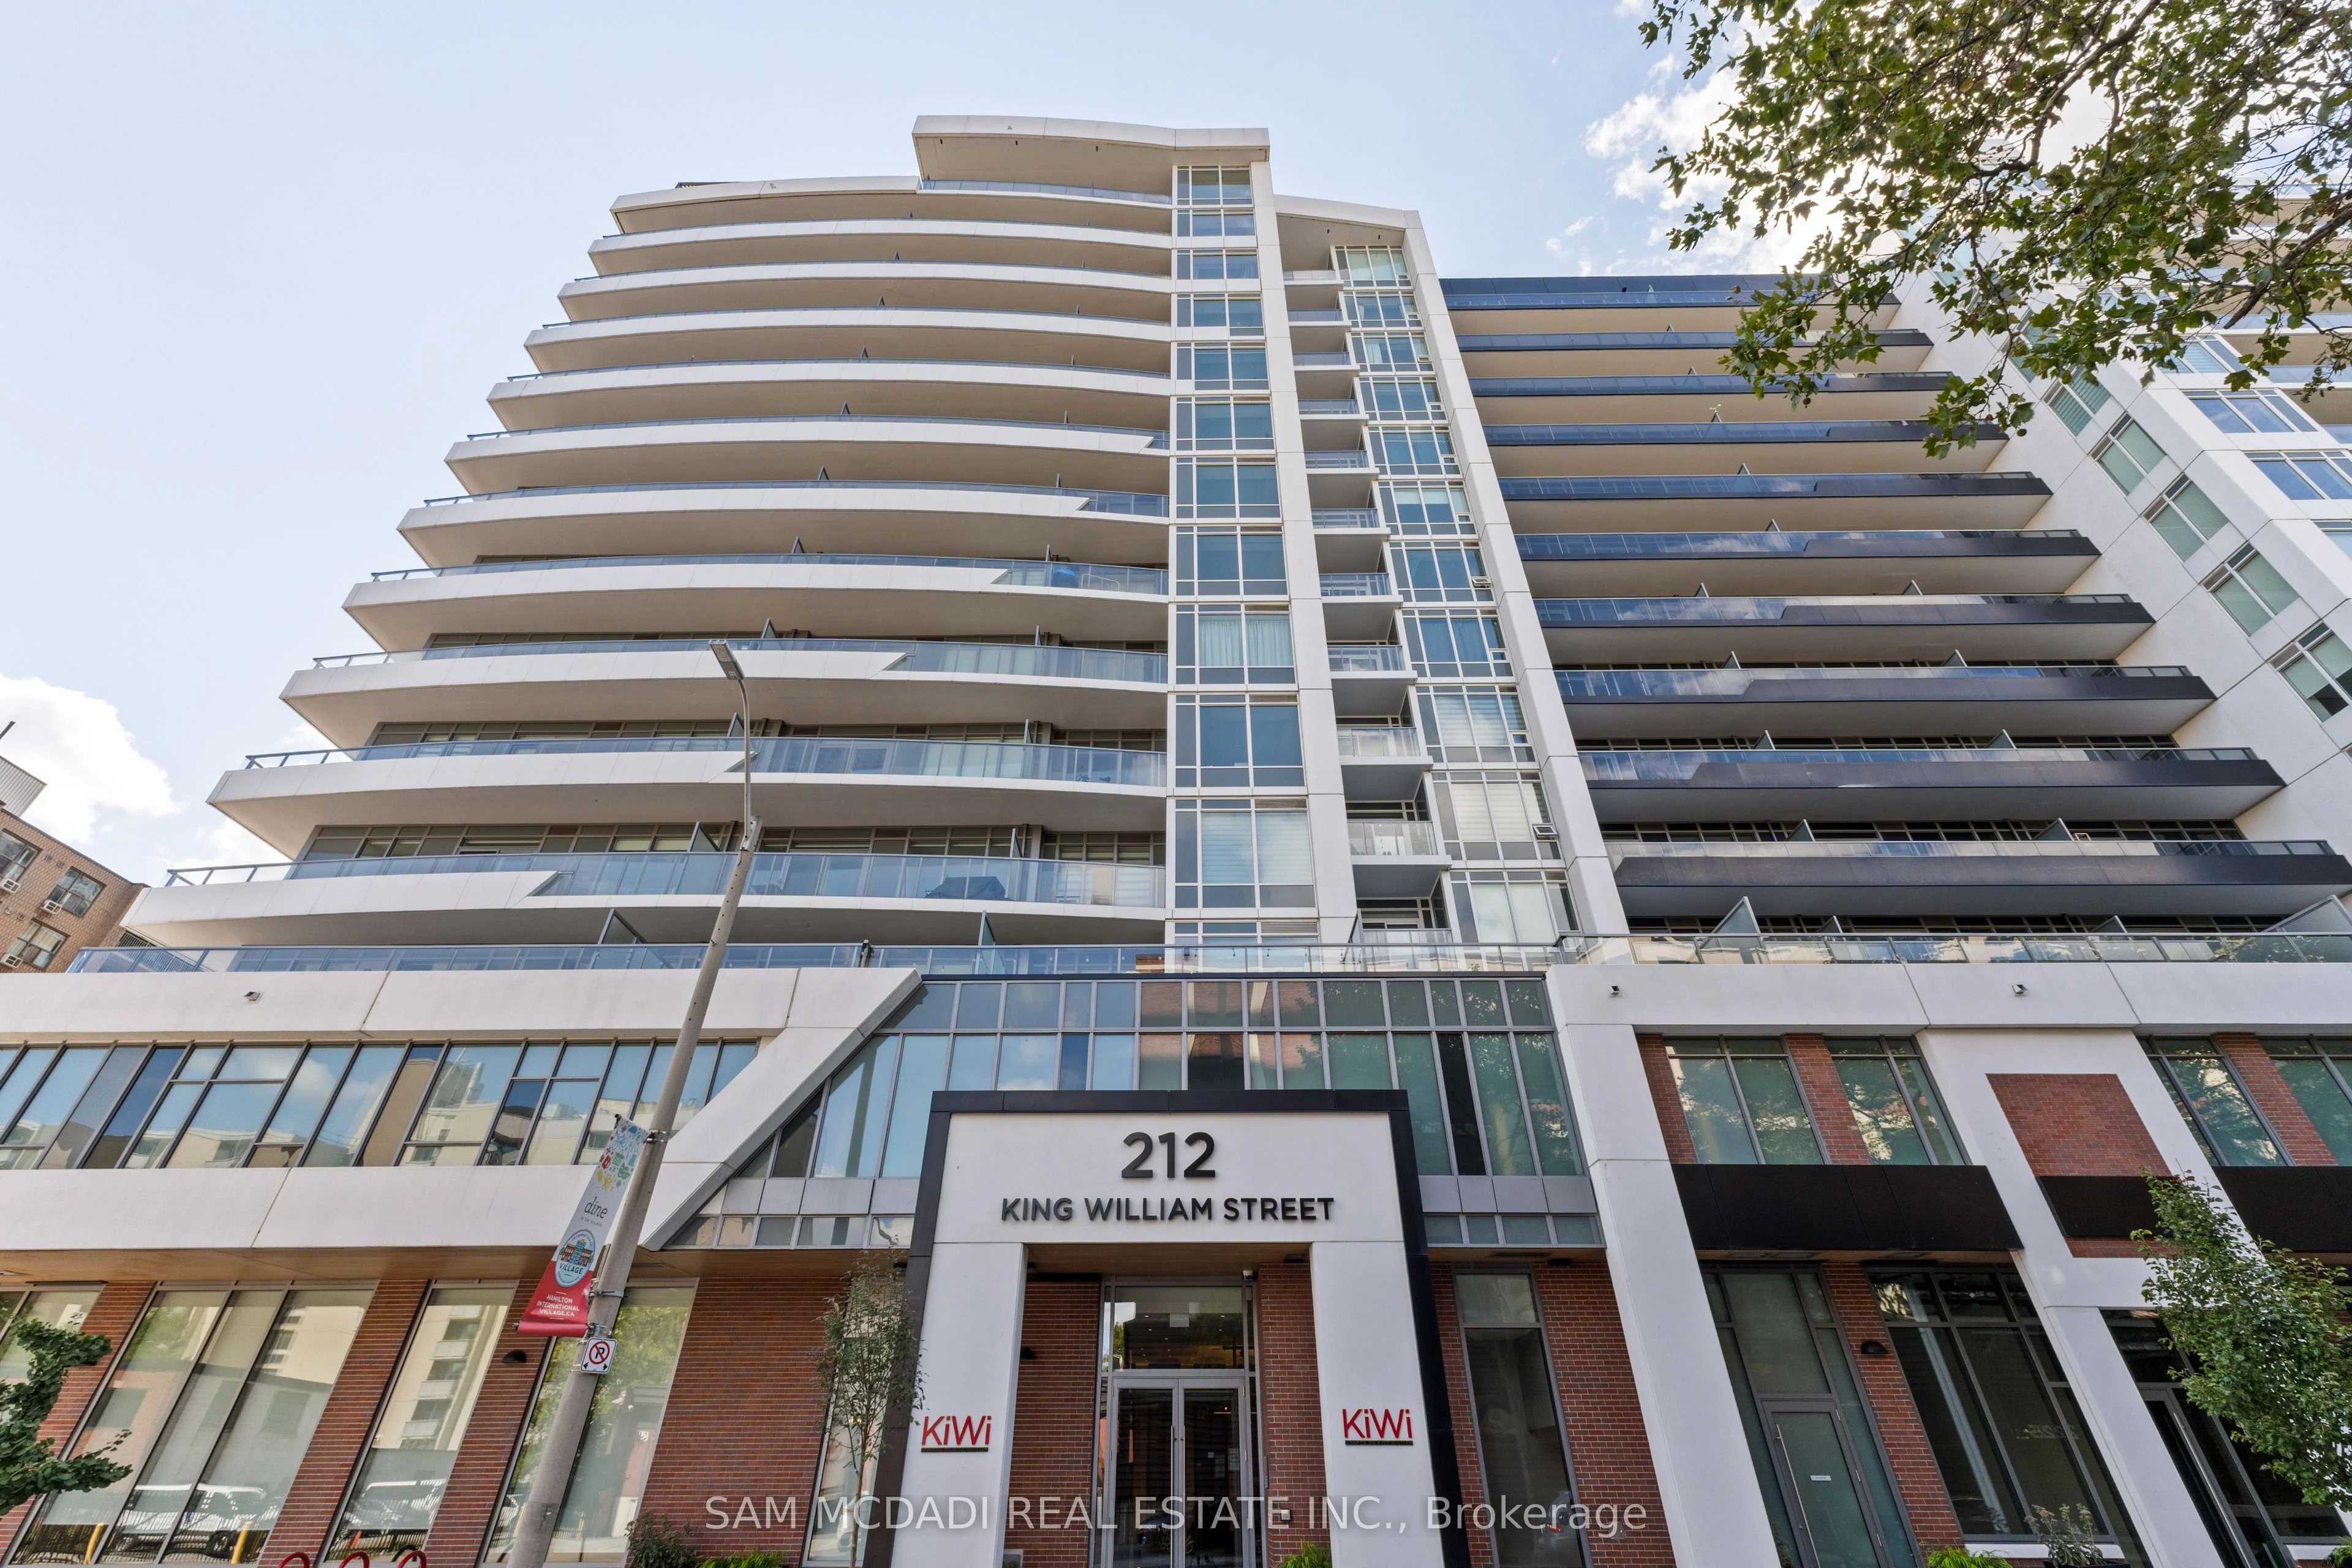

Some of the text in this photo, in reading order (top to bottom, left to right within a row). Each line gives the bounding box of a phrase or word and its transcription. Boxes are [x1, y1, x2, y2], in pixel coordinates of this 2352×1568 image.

[1121, 1131, 1216, 1180] 212
[584, 1196, 608, 1218] dine
[1001, 1197, 1335, 1222] KING WILLIAM STREET
[559, 1263, 584, 1274] VILLAGE
[537, 1300, 580, 1311] INTERNATIONAL
[546, 1294, 573, 1303] HAMILTON
[595, 1347, 605, 1359] P
[921, 1415, 992, 1446] KiWi
[1342, 1408, 1412, 1438] KiWi
